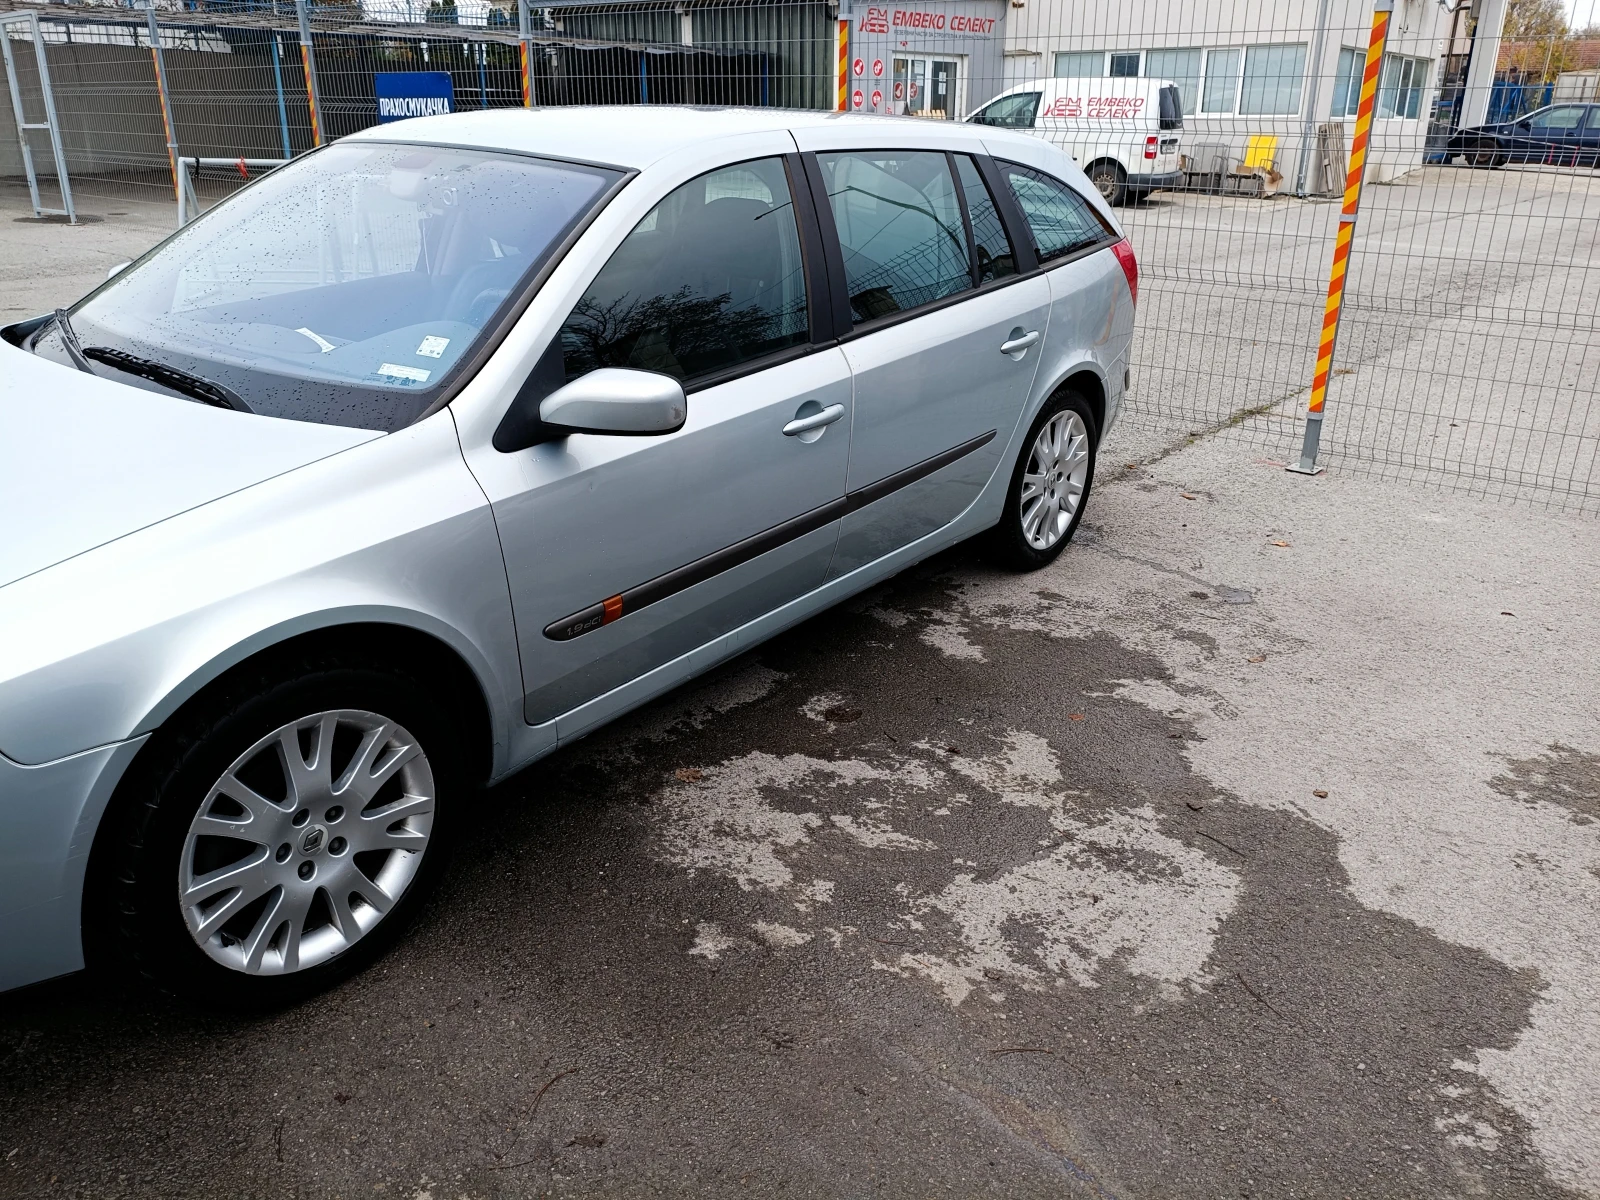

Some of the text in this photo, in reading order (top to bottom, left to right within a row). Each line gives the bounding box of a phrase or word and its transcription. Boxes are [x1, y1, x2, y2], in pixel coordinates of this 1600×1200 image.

[892, 10, 995, 33] ЕМВЕКО СЕЛЕКТ
[379, 97, 450, 117] ПРАХОСМУКАЧКА
[1087, 97, 1145, 108] ЕМВЕКО
[1087, 108, 1142, 119] СЕЛЕКТ
